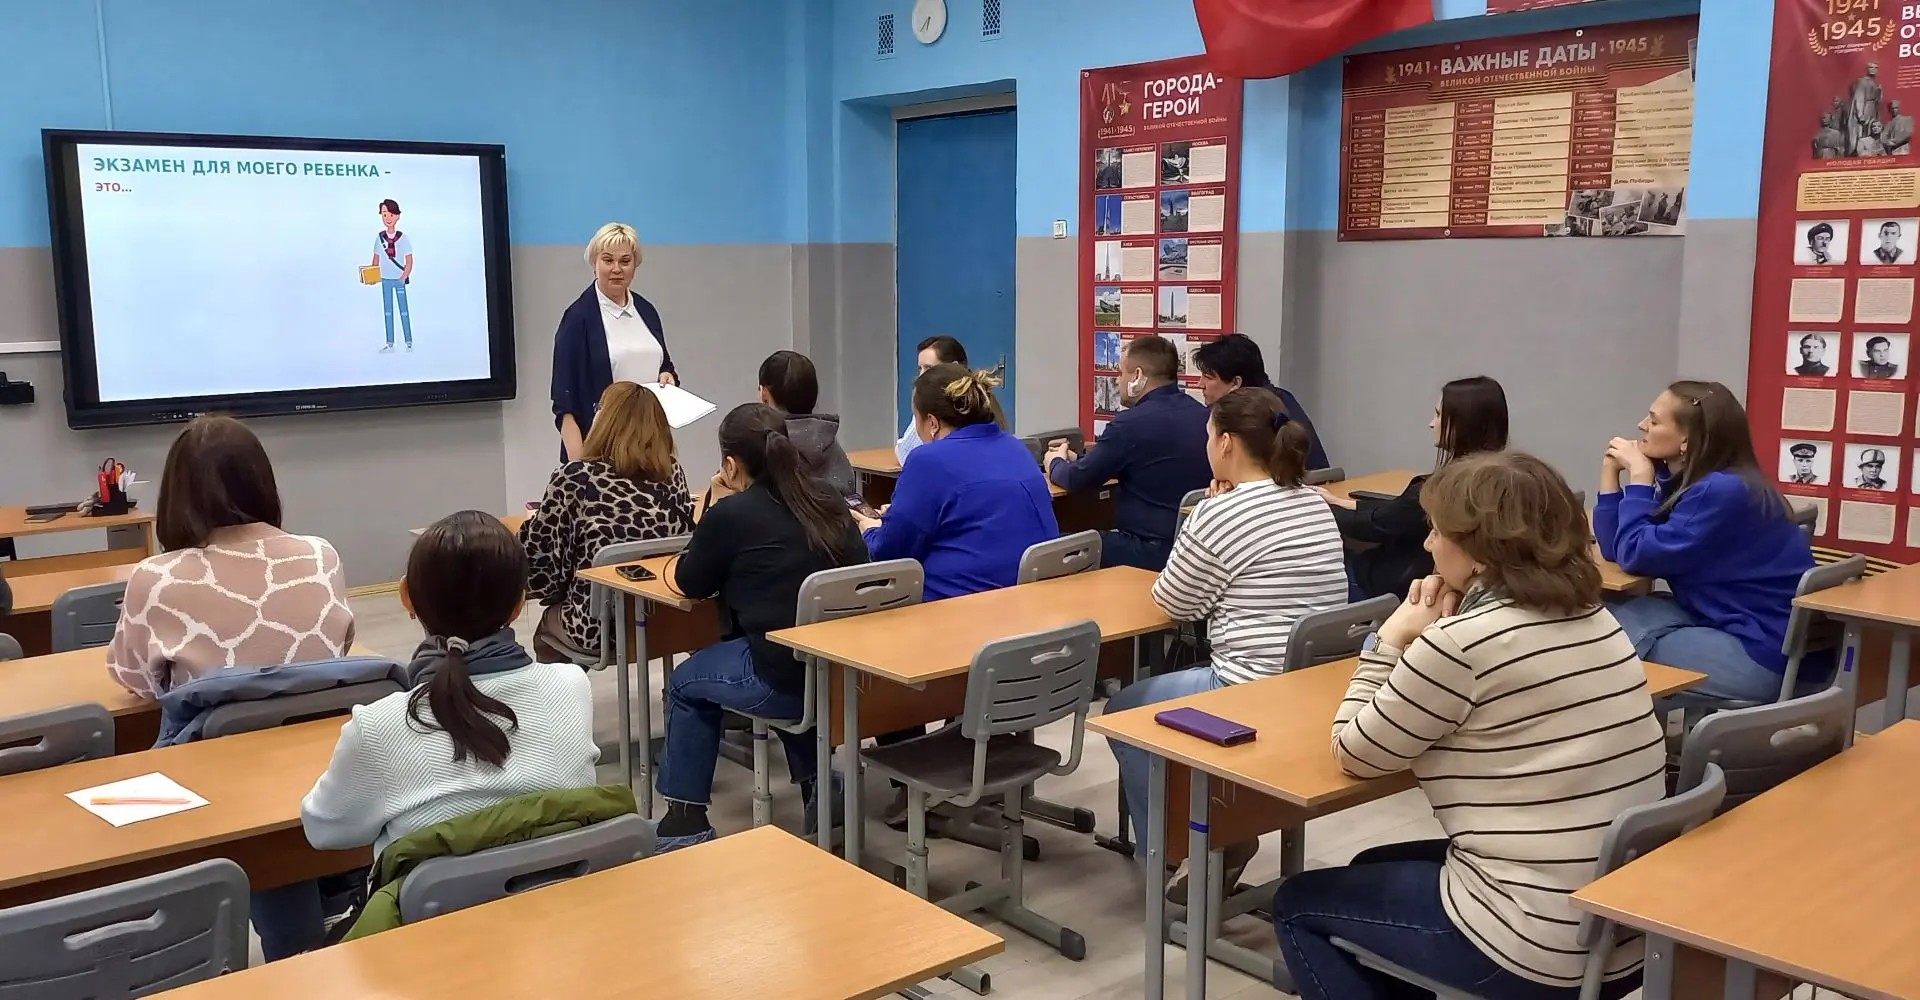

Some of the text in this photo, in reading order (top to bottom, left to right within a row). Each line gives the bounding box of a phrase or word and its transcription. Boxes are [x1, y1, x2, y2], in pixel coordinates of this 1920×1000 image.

[1820, 17, 1880, 40] 1945
[1398, 37, 1648, 76] 1941 ВАЖНЫЕ ДАТЫ 1945
[1144, 72, 1223, 98] ГОРОДА-
[1440, 66, 1595, 88] ВЕЛИКОЙ ОТЕЧЕСТВЕННОЙ ВОЙНЫ
[1144, 96, 1200, 120] ГЕРОИ
[93, 158, 185, 172] ЭКЗАМЕН
[192, 160, 230, 176] ДЛЯ
[237, 161, 297, 175] МОЕГО
[304, 162, 379, 177] РЕБЕНКА
